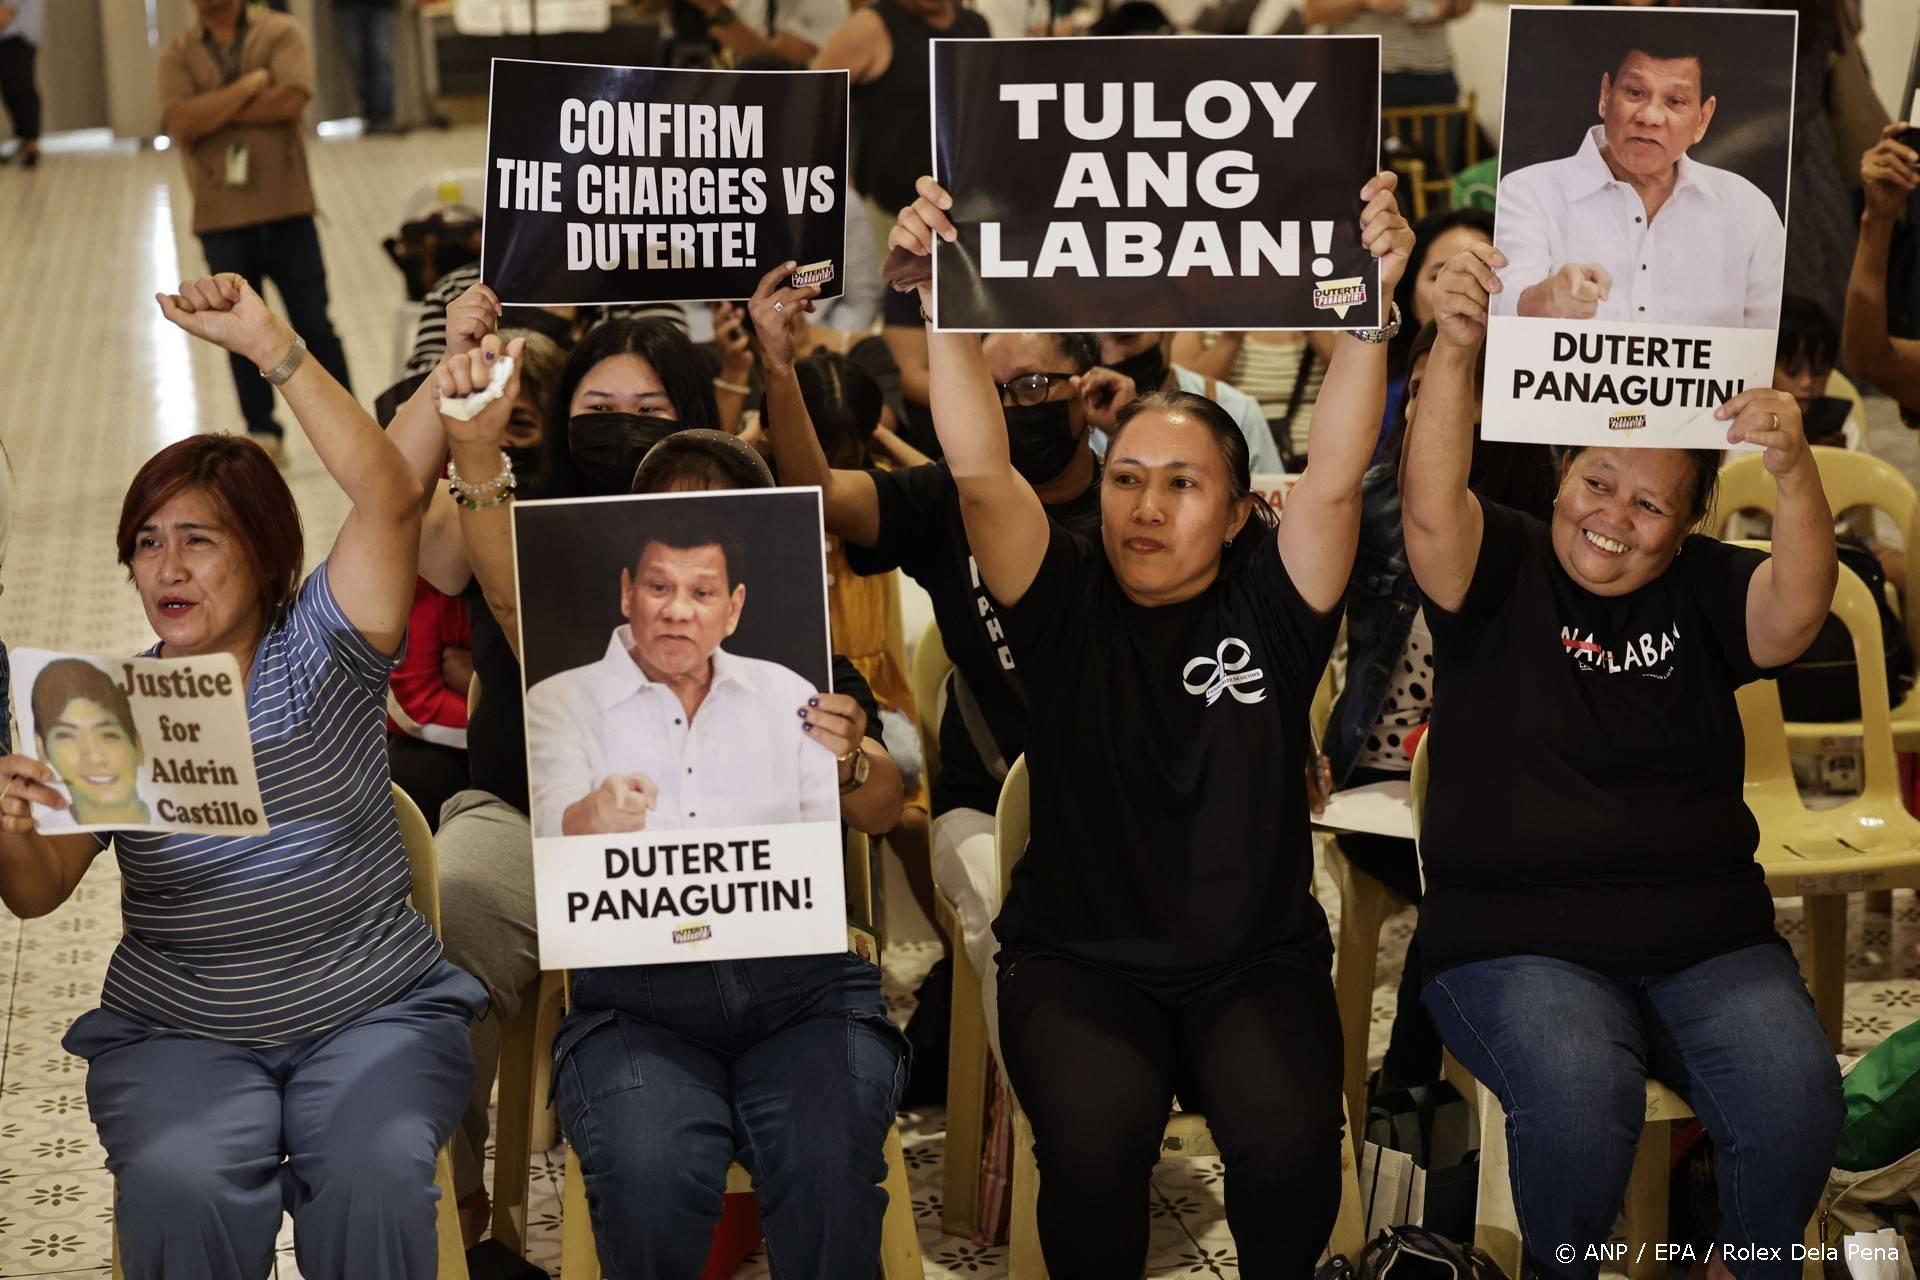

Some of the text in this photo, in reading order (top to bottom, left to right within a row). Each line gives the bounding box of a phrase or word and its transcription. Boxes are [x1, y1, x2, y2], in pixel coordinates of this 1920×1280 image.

[559, 98, 764, 159] CONFIRM
[999, 79, 1318, 141] TULOY
[496, 157, 836, 215] THE CHARGES VS
[1053, 149, 1260, 210] ANG
[566, 221, 758, 272] DUTERTE!
[979, 219, 1336, 278] LABAN!
[1314, 285, 1365, 298] DUTERTE
[1552, 331, 1713, 371] DUTERTE
[119, 663, 233, 699] Justice
[158, 714, 202, 743] for
[151, 757, 239, 786] Aldrin
[156, 798, 259, 826] Castillo
[604, 839, 772, 879] DUTERTE
[567, 877, 815, 923] PANAGUTIN!
